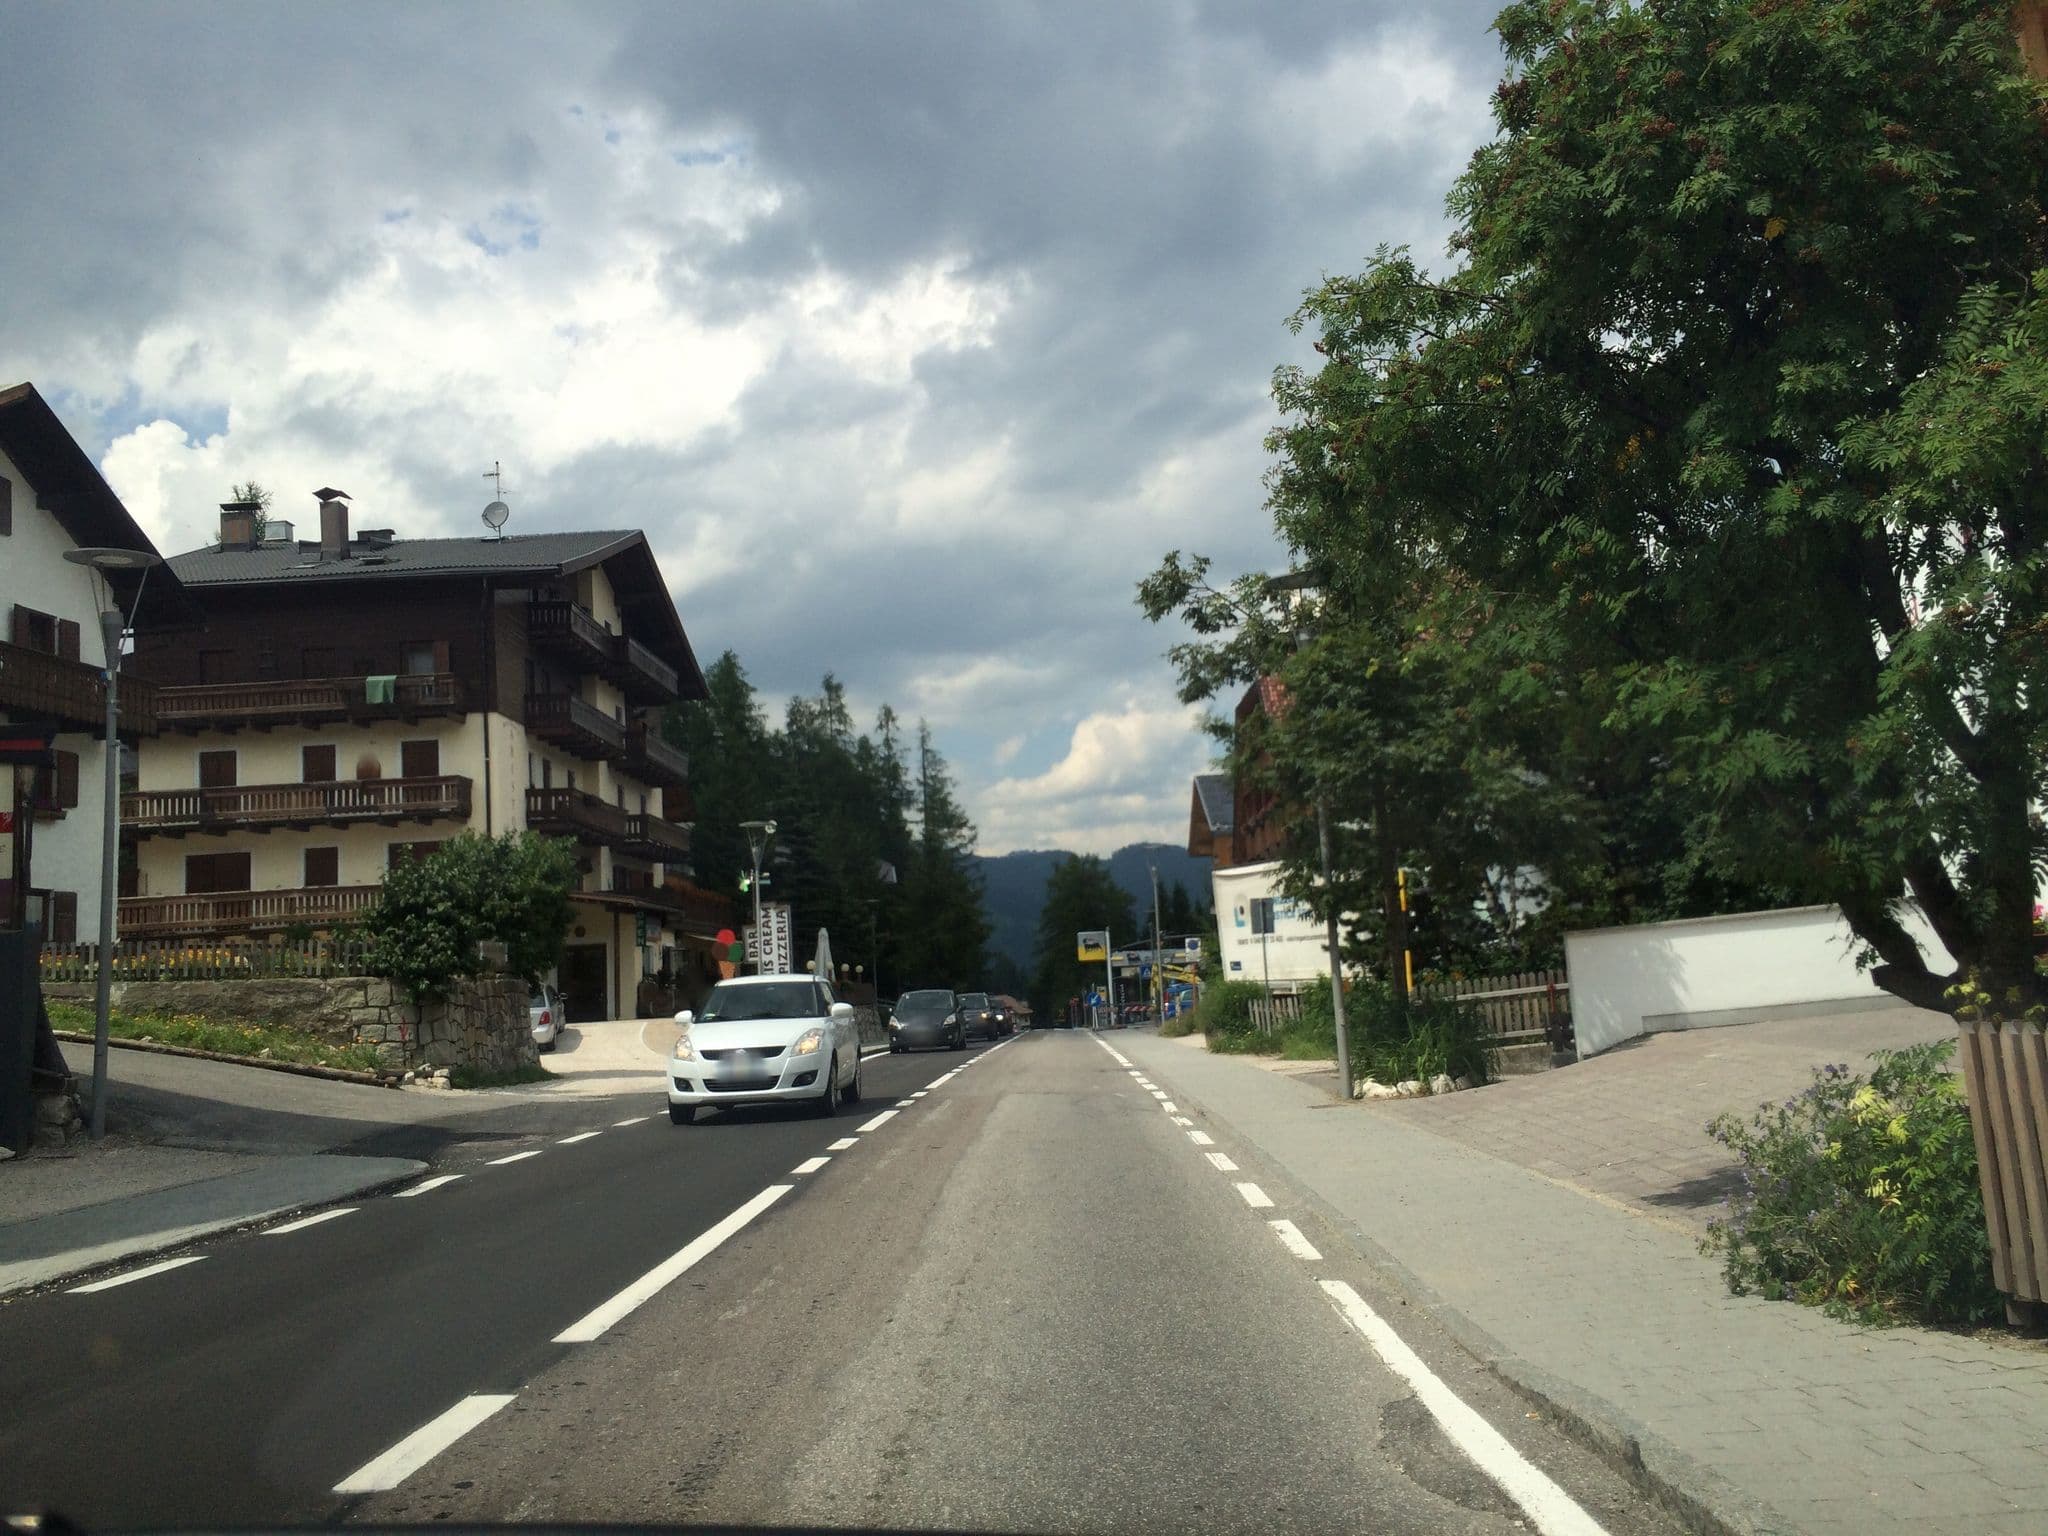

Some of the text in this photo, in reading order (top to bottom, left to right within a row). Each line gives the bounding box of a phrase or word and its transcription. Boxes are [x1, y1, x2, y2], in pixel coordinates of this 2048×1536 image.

[748, 930, 759, 959] BAR
[761, 906, 774, 956] CREAM
[776, 910, 789, 975] PIZZERIA
